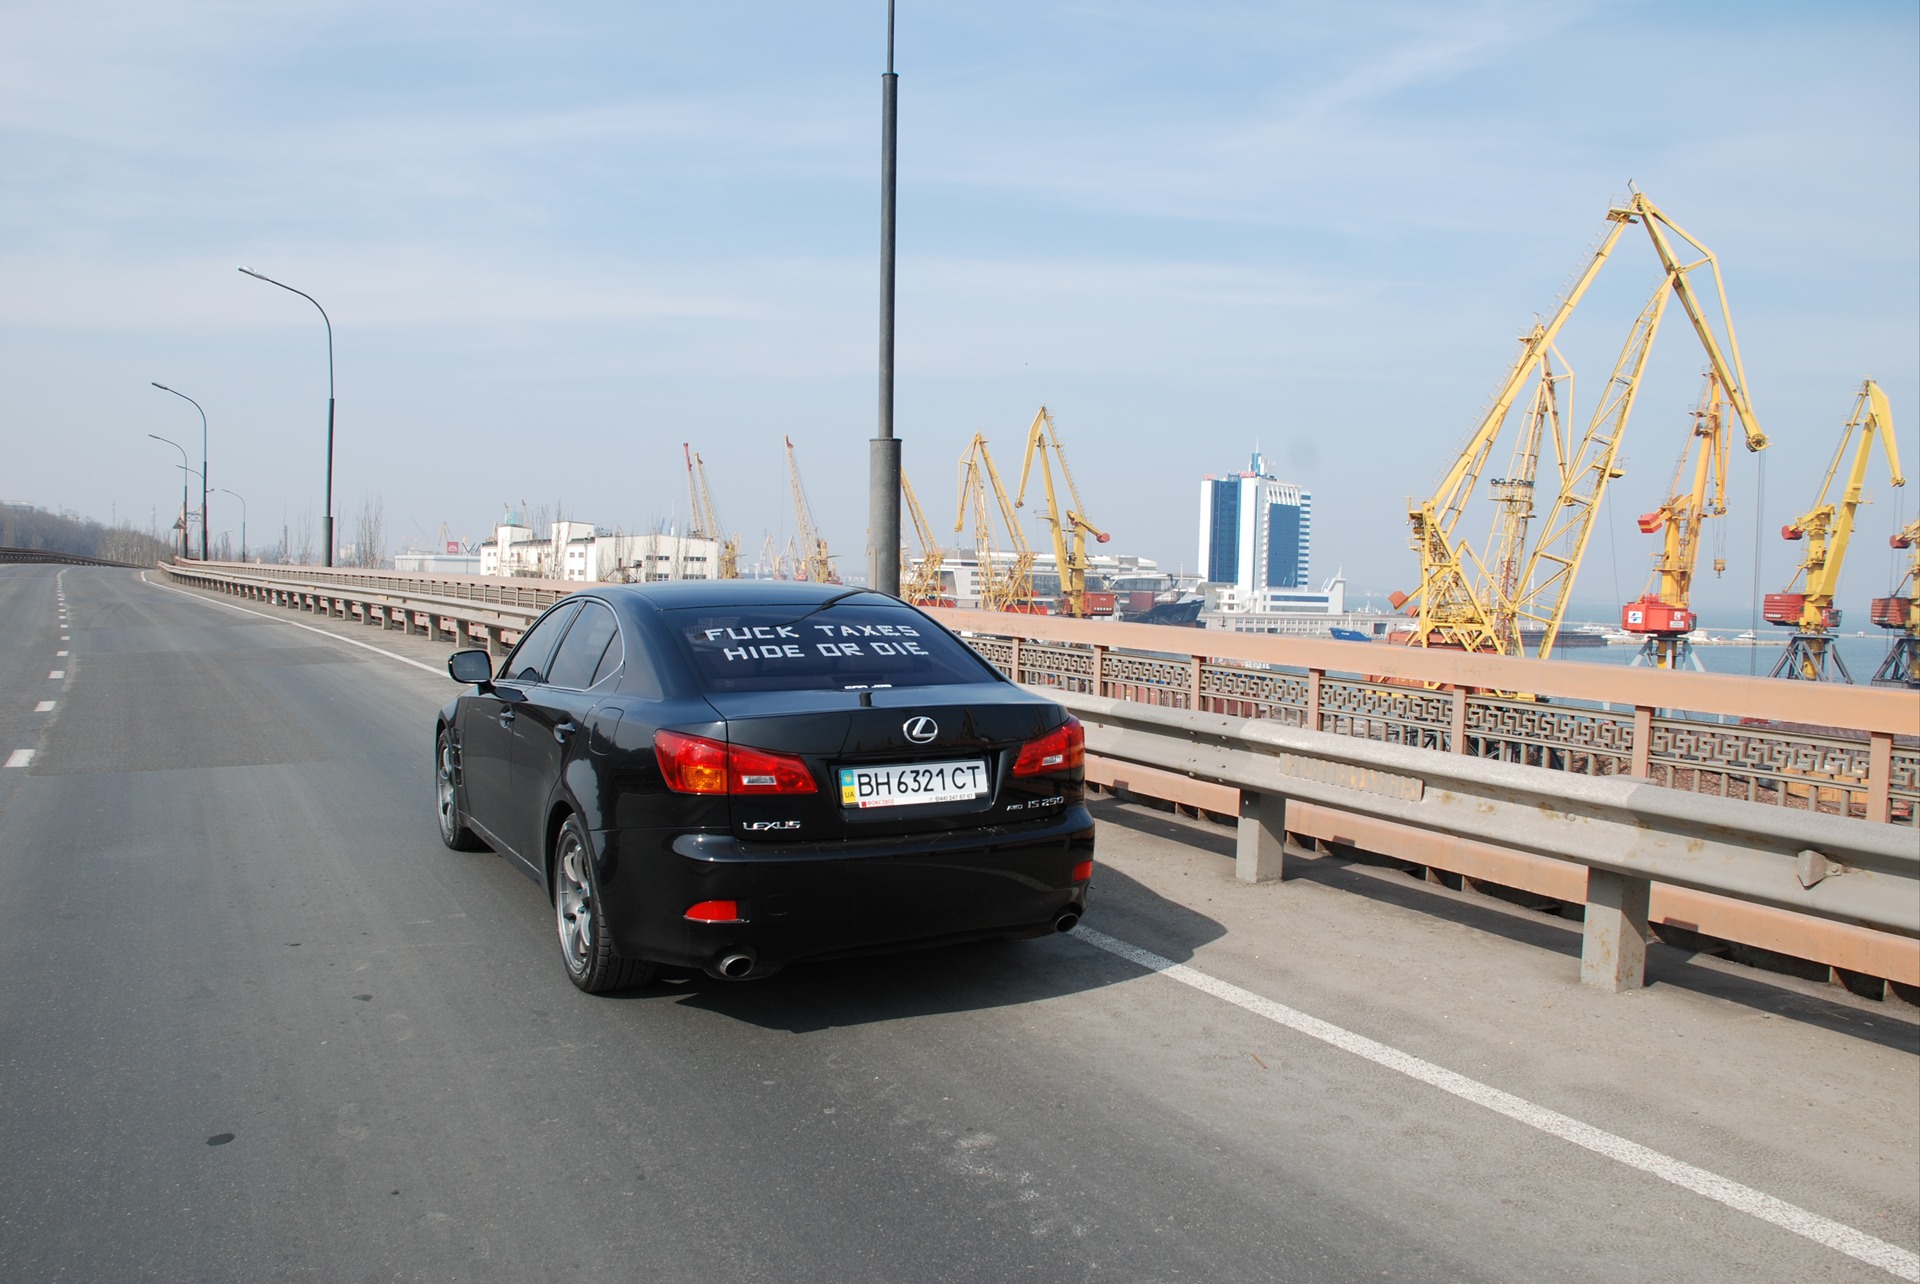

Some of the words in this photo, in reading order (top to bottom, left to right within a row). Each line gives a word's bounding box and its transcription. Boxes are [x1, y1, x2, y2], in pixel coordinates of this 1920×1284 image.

[704, 626, 799, 641] FUCK
[814, 625, 920, 637] TAXES
[723, 645, 805, 661] HIDE
[816, 643, 864, 657] OR
[869, 642, 929, 656] DIE
[857, 772, 891, 797] BH
[897, 768, 945, 794] 6321
[951, 766, 980, 789] CT
[1027, 800, 1039, 808] IS
[1041, 796, 1064, 806] 250
[743, 821, 800, 830] LEXUS
